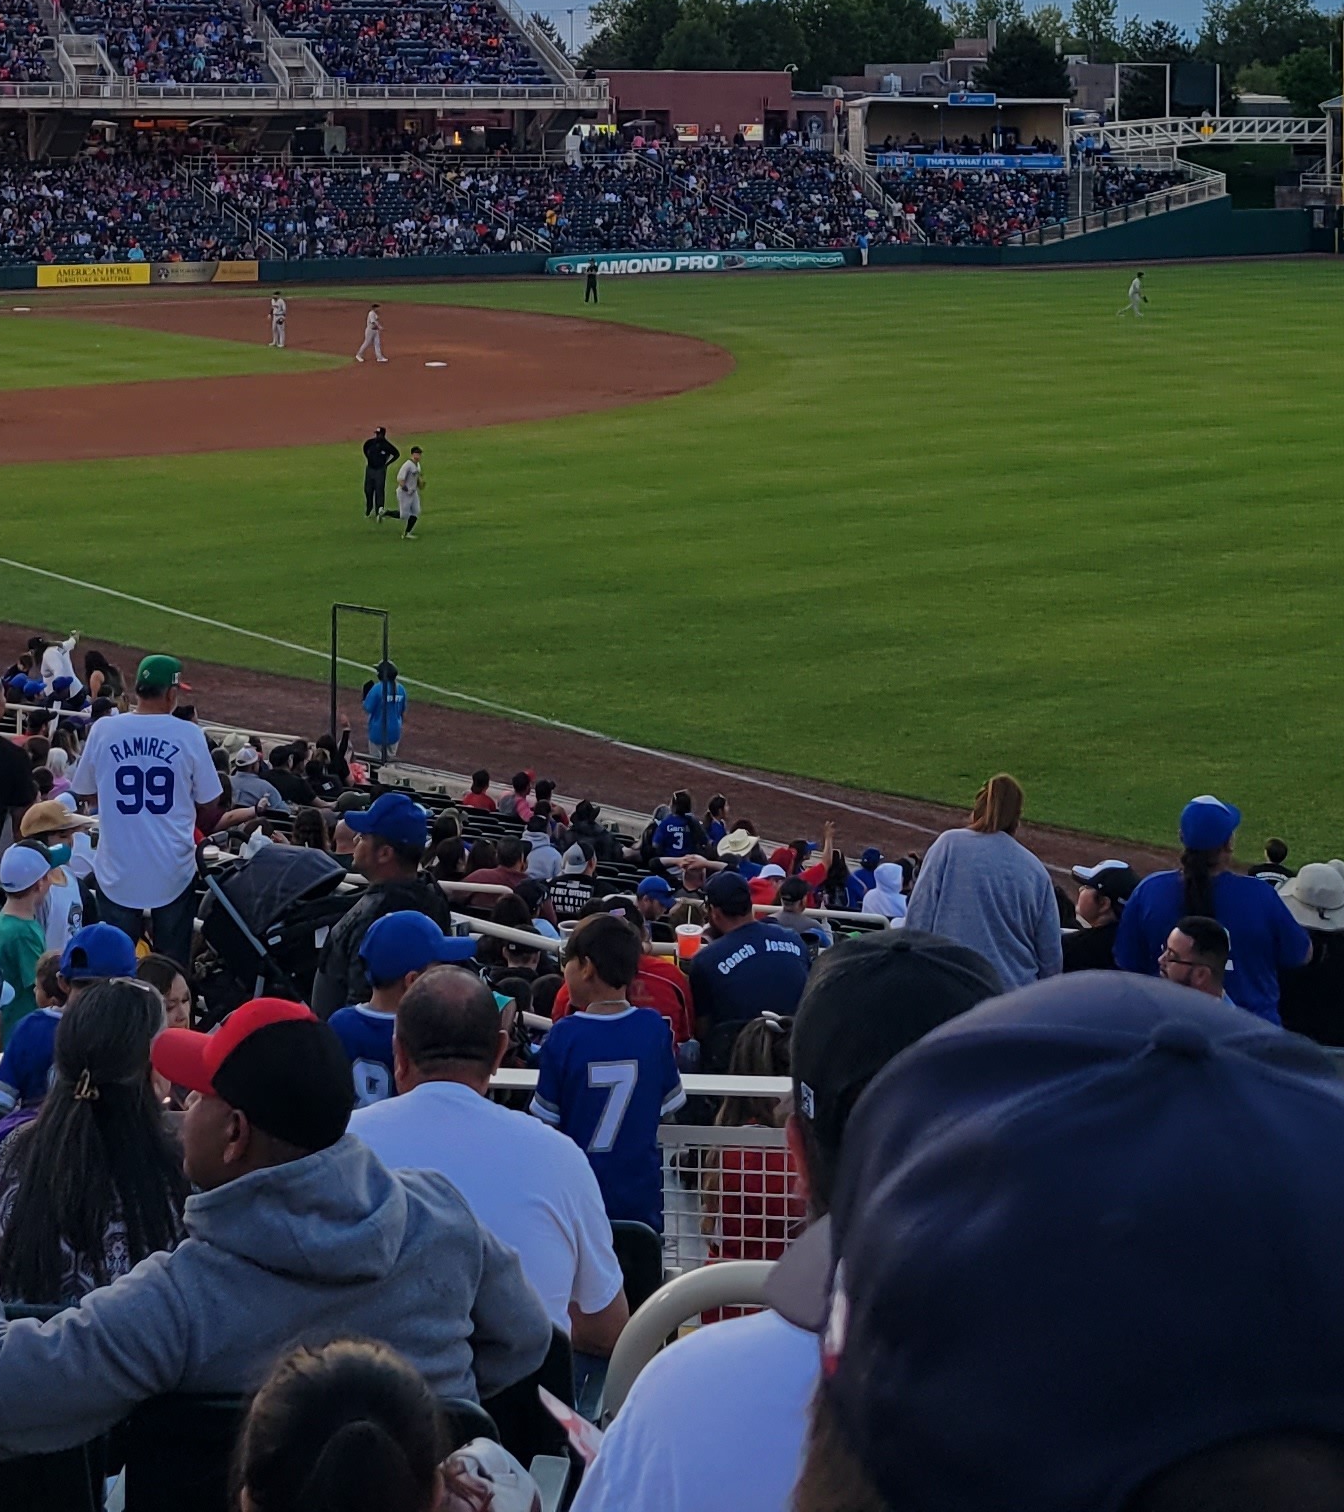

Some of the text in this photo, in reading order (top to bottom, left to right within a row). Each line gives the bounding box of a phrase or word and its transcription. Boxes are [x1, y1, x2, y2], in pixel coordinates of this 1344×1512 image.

[926, 157, 955, 166] THAT'S
[956, 157, 982, 166] WHAT
[987, 158, 1006, 167] LIKE
[575, 255, 719, 275] DAMOND PRO
[746, 253, 844, 267] diamondpro.com
[56, 267, 104, 276] AMERICAN
[109, 737, 181, 765] RAMIREZ
[114, 764, 175, 815] 99
[672, 831, 684, 850] 3
[717, 943, 757, 975] Coach
[587, 1059, 639, 1153] 7
